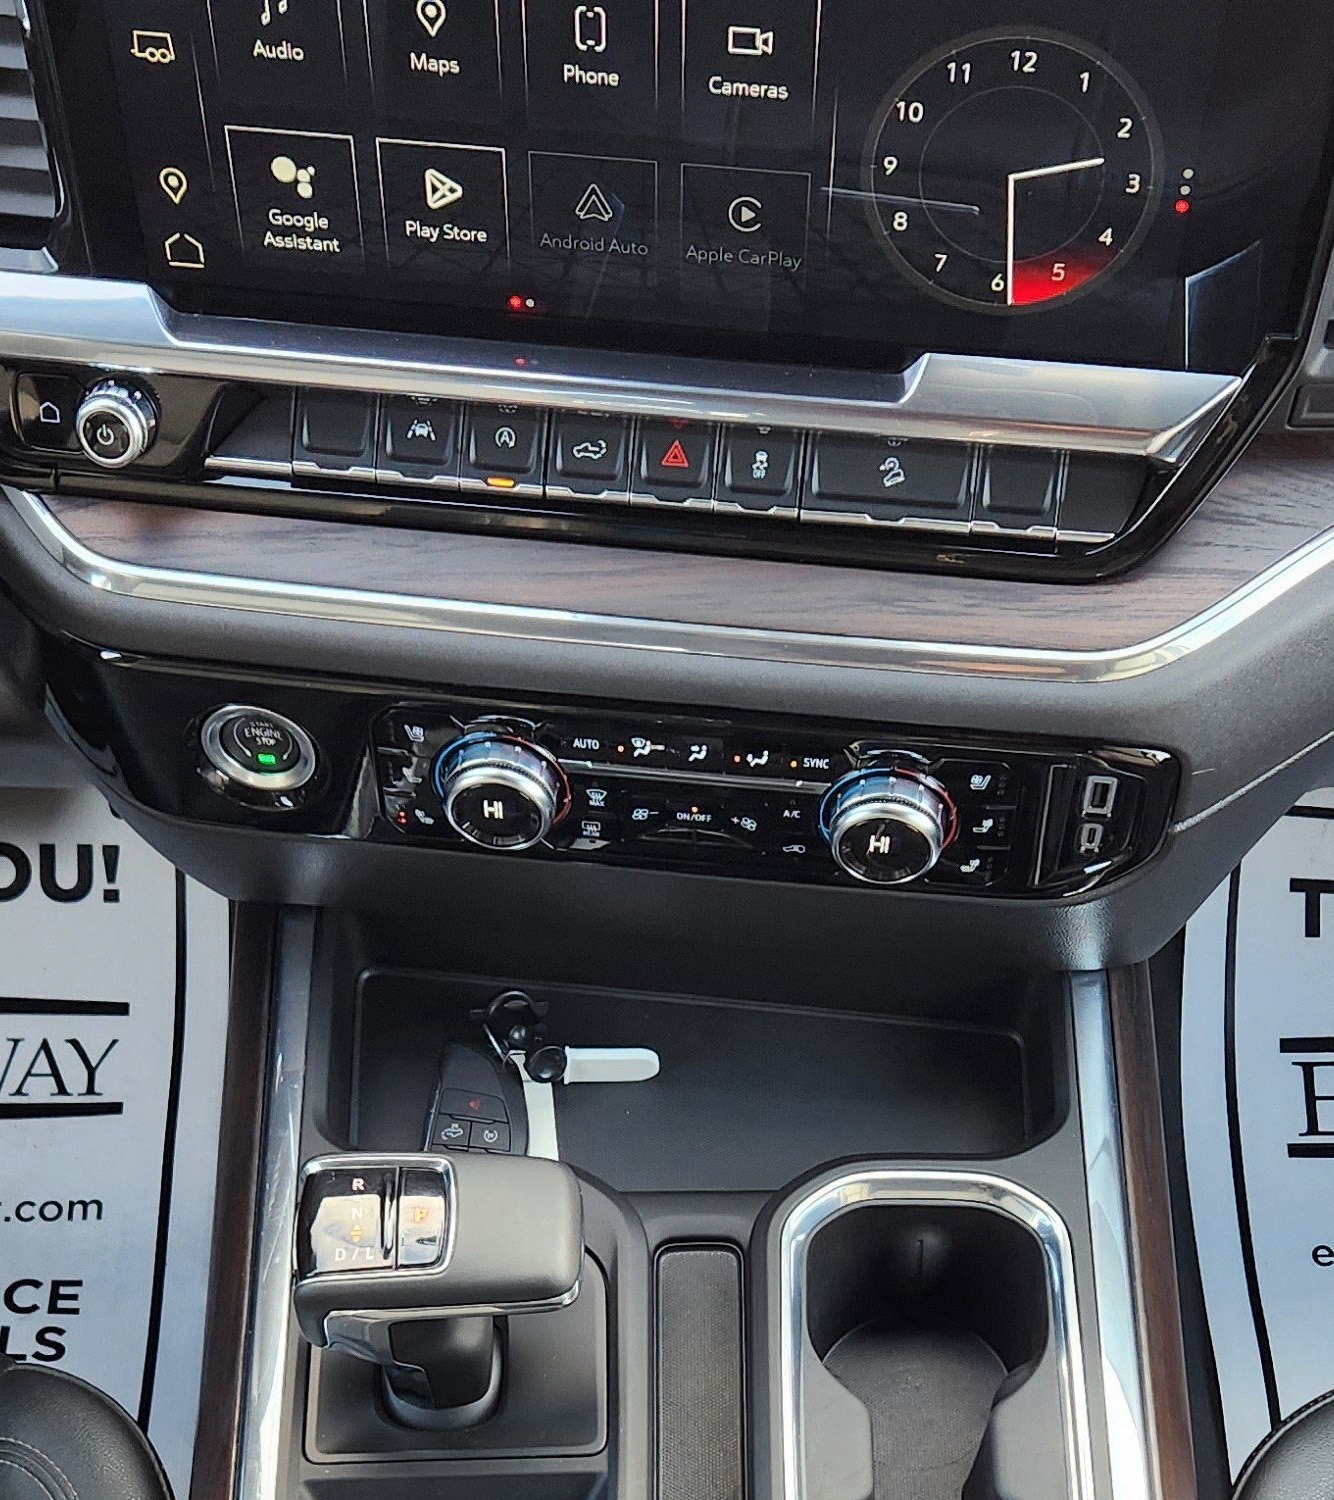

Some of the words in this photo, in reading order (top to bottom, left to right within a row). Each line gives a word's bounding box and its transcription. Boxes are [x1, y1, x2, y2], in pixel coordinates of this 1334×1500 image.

[253, 39, 304, 61] Audio
[410, 53, 460, 76] Maps
[1010, 50, 1038, 73] 12
[563, 64, 620, 87] Phone
[947, 62, 972, 84] 11
[1079, 72, 1090, 92] 1
[708, 76, 789, 100] Cameras
[896, 101, 924, 123] 10
[1117, 118, 1133, 139] 2
[883, 156, 898, 176] 9
[1125, 174, 1141, 194] 3
[267, 209, 329, 232] Google
[893, 211, 908, 231] 8
[405, 220, 440, 243] Play
[443, 224, 488, 243] Store
[1098, 227, 1113, 246] 4
[264, 231, 340, 253] Assistant
[540, 232, 605, 252] Android
[608, 238, 649, 256] Auto
[685, 245, 734, 265] Apple
[738, 248, 802, 271] CarPlay
[934, 253, 948, 272] 7
[991, 273, 1005, 291] 6
[1050, 263, 1066, 281] 5
[244, 728, 282, 741] ENGINE
[256, 737, 277, 746] STOP
[572, 737, 600, 750] AUTO
[802, 757, 830, 770] SYNC
[483, 800, 504, 819] HI
[676, 812, 712, 823] ON/OFF
[782, 810, 801, 819] A/C
[869, 835, 891, 854] HI
[352, 1178, 365, 1190] R
[352, 1207, 362, 1219] N
